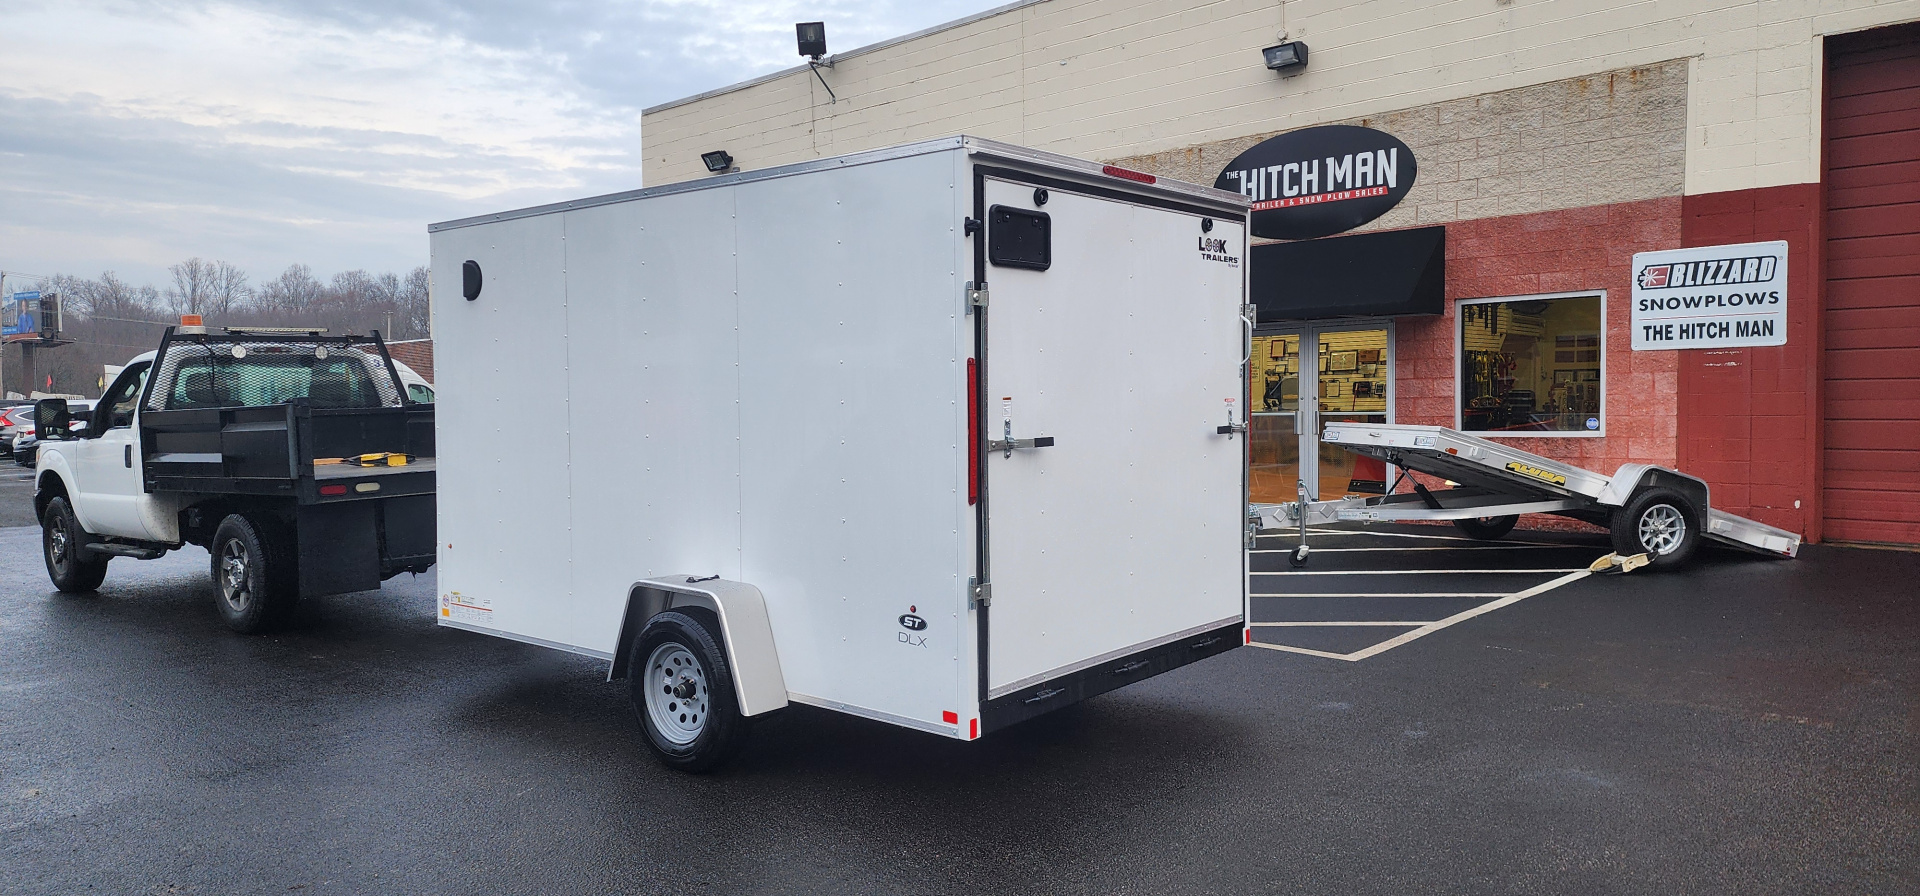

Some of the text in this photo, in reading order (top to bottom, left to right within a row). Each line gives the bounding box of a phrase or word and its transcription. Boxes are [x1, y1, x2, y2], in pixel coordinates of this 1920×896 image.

[1226, 148, 1397, 201] THE HITCH MAN
[1251, 186, 1384, 209] TRAILER & SNOW PLOW SALES
[1199, 237, 1227, 254] LOOK
[1201, 253, 1239, 264] TRAILERS
[1670, 257, 1773, 287] BLIZZARD
[1639, 291, 1779, 311] SNOWPLOWS
[1643, 319, 1774, 341] THE HITCH MAN
[1507, 462, 1566, 484] ALUMA
[903, 616, 921, 628] ST
[898, 631, 927, 648] DLX
